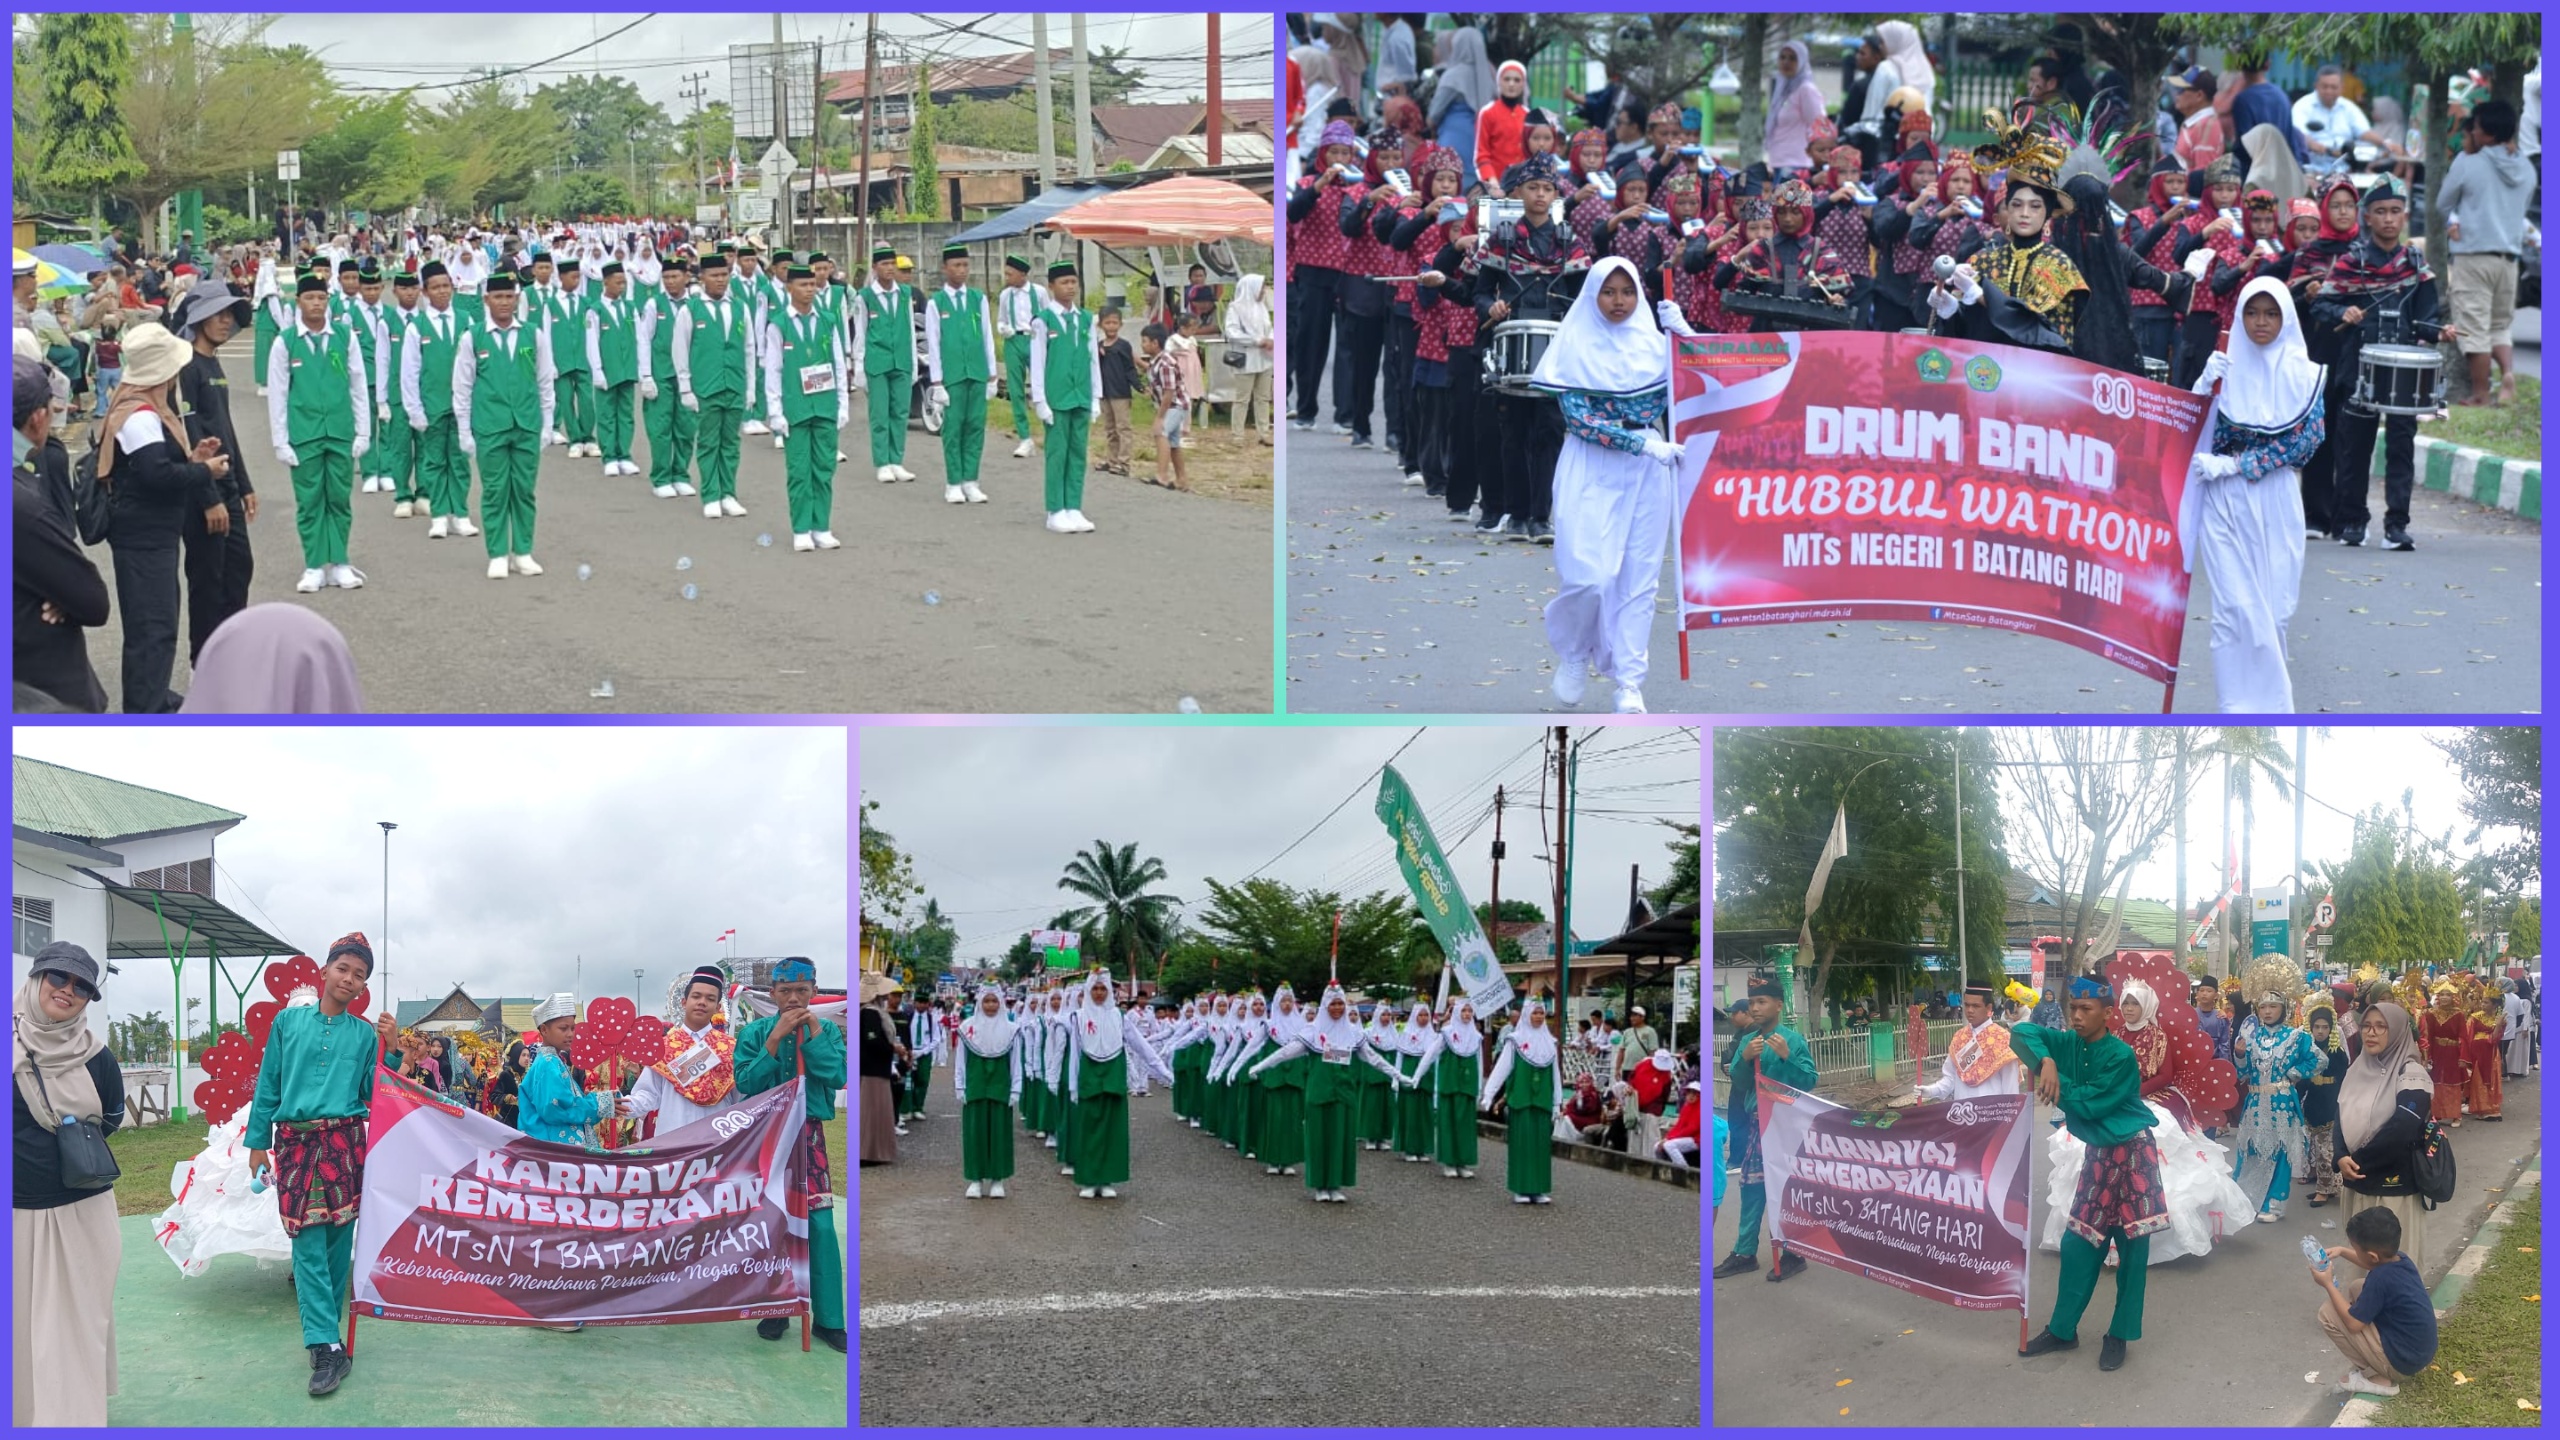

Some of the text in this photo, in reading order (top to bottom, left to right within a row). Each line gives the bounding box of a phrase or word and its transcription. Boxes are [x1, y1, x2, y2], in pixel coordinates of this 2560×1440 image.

[1678, 341, 1790, 354] MADRASAH
[2092, 371, 2135, 419] 80
[1805, 405, 2116, 491] DRUM BAND
[1783, 532, 2124, 605] MTs NEGERI 1 BATANG HARI
[1943, 611, 2036, 631] MtsnSatu BatangHari
[2266, 899, 2282, 907] PLN
[688, 1060, 707, 1077] 06
[1966, 1054, 1976, 1065] 06
[1803, 1130, 1957, 1170] KARNAVAL
[418, 1172, 764, 1231] KEMERDEKAAN
[1784, 1154, 1985, 1213] KEMERDEKAAN
[414, 1221, 770, 1270] MTsN 1 BATANG HARI
[1859, 1198, 1932, 1237] BATANG
[1936, 1215, 1983, 1250] HARI
[1836, 1220, 1875, 1241] Membawa
[1875, 1230, 1924, 1256] Persatuan,
[1926, 1244, 1957, 1265] Negsa
[1958, 1252, 2013, 1274] Berjaya
[383, 1256, 506, 1286] Keberagaman
[508, 1272, 598, 1290] Membawa
[601, 1268, 681, 1291] Persatuan,
[685, 1258, 740, 1282] Negsa
[751, 1306, 796, 1316] mtsn1batari
